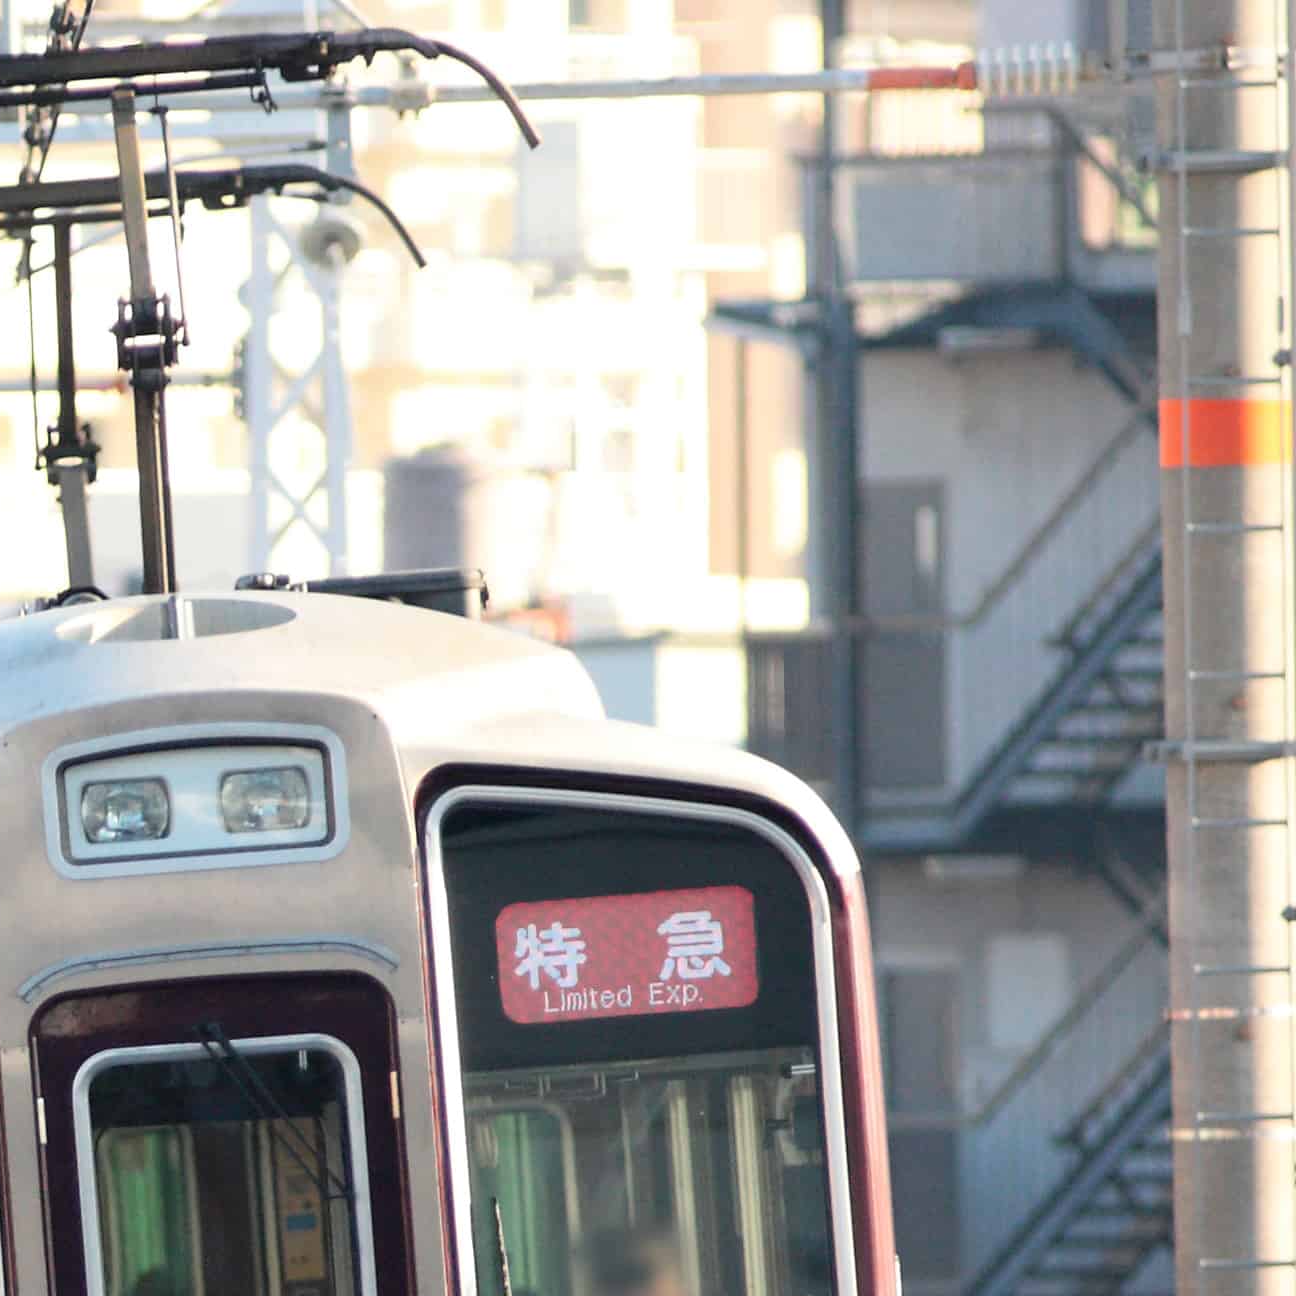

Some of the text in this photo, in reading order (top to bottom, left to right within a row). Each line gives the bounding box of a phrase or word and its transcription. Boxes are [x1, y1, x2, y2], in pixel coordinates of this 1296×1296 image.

[514, 910, 732, 990] 特急
[543, 980, 704, 1013] Limited Exp.
